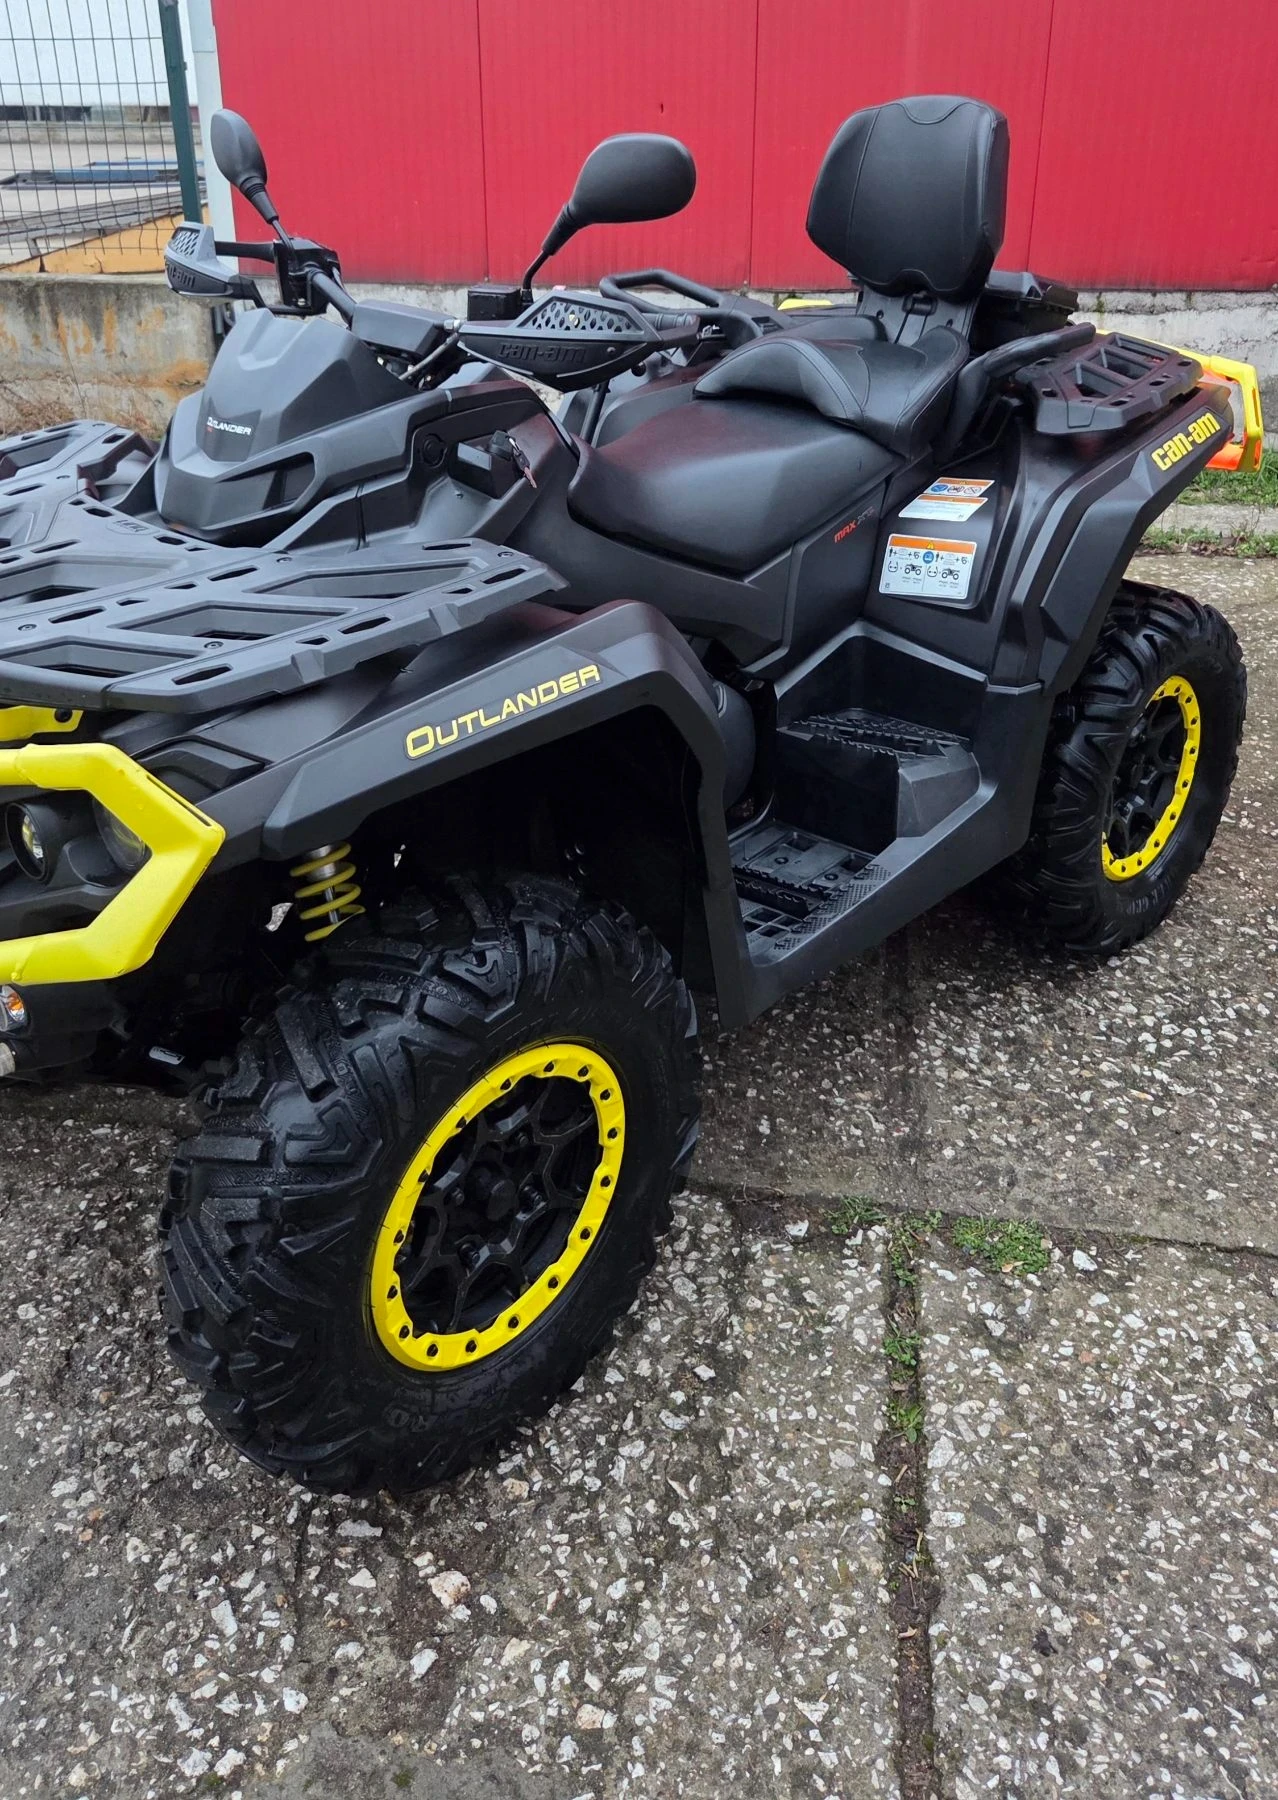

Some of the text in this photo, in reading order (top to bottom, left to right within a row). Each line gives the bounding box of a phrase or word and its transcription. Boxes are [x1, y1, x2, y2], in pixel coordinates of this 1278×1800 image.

[499, 342, 586, 363] can-am
[1151, 412, 1221, 471] can-am
[406, 664, 601, 758] OUTLANDER
